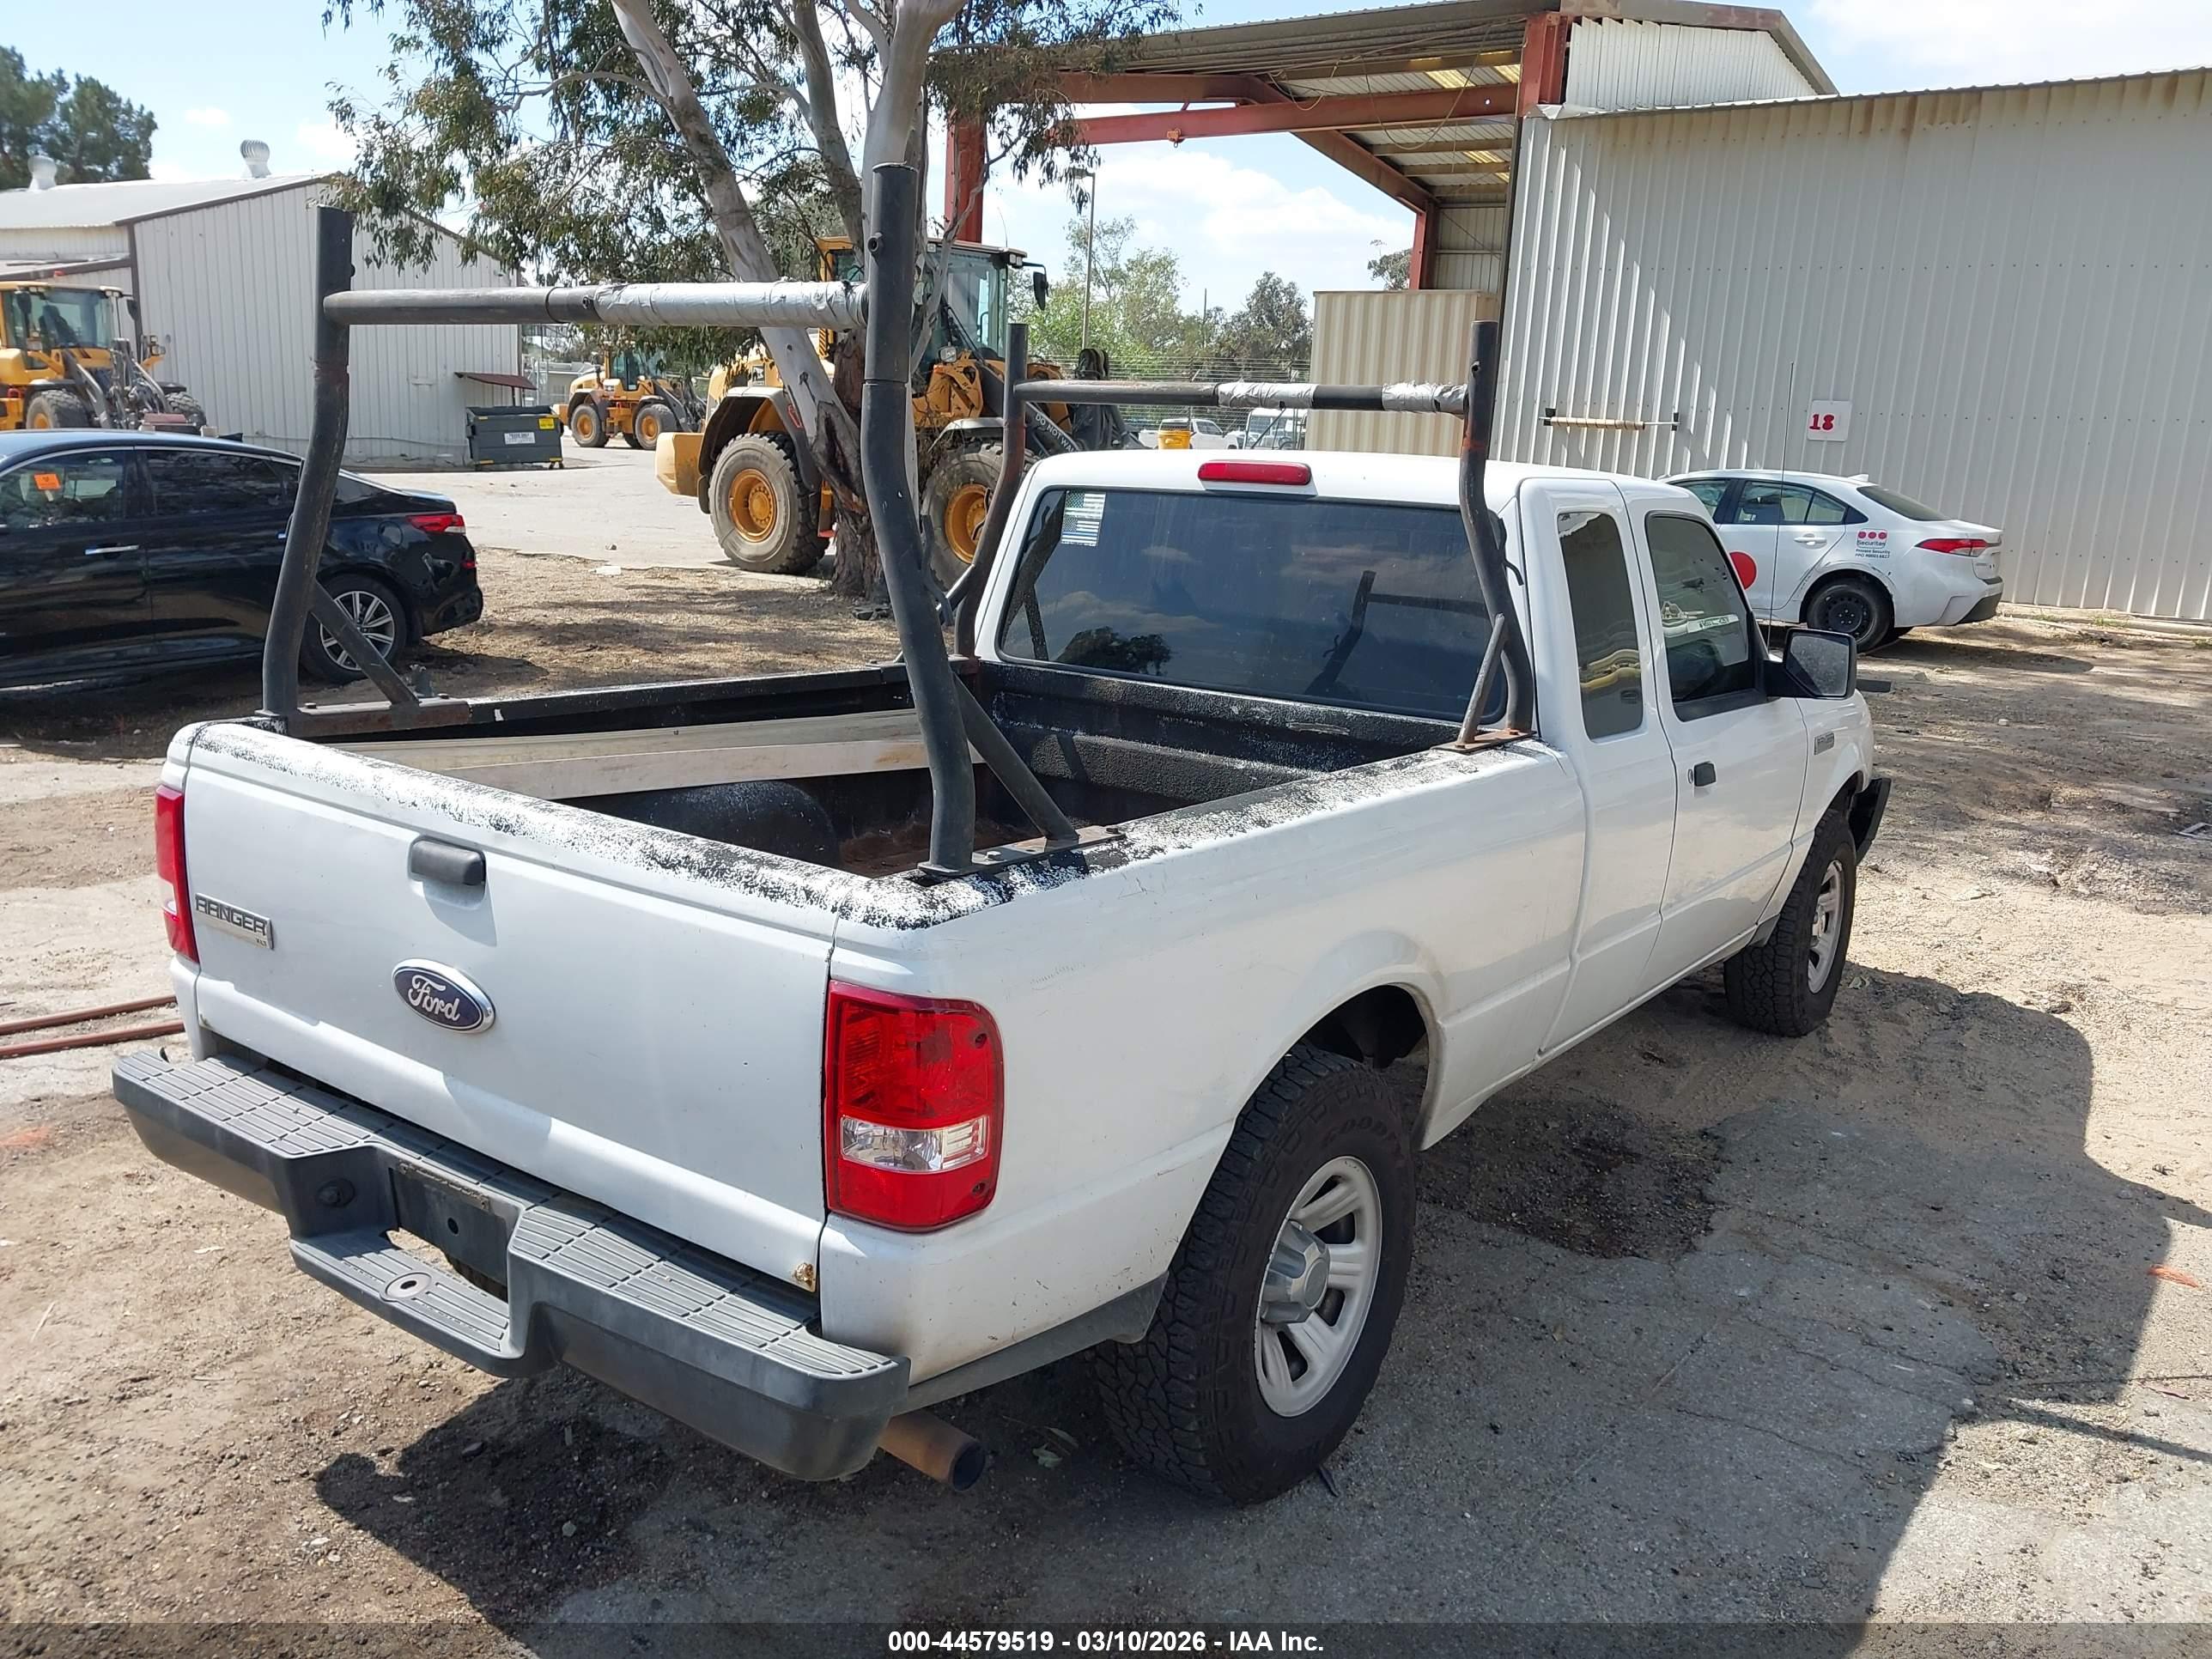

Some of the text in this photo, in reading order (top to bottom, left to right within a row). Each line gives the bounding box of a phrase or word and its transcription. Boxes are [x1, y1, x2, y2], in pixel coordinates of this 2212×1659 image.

[1036, 414, 1046, 425] DO
[1047, 424, 1061, 439] NOT
[1809, 414, 1835, 430] 18
[196, 895, 267, 936] RANGER
[408, 975, 460, 1021] Ford
